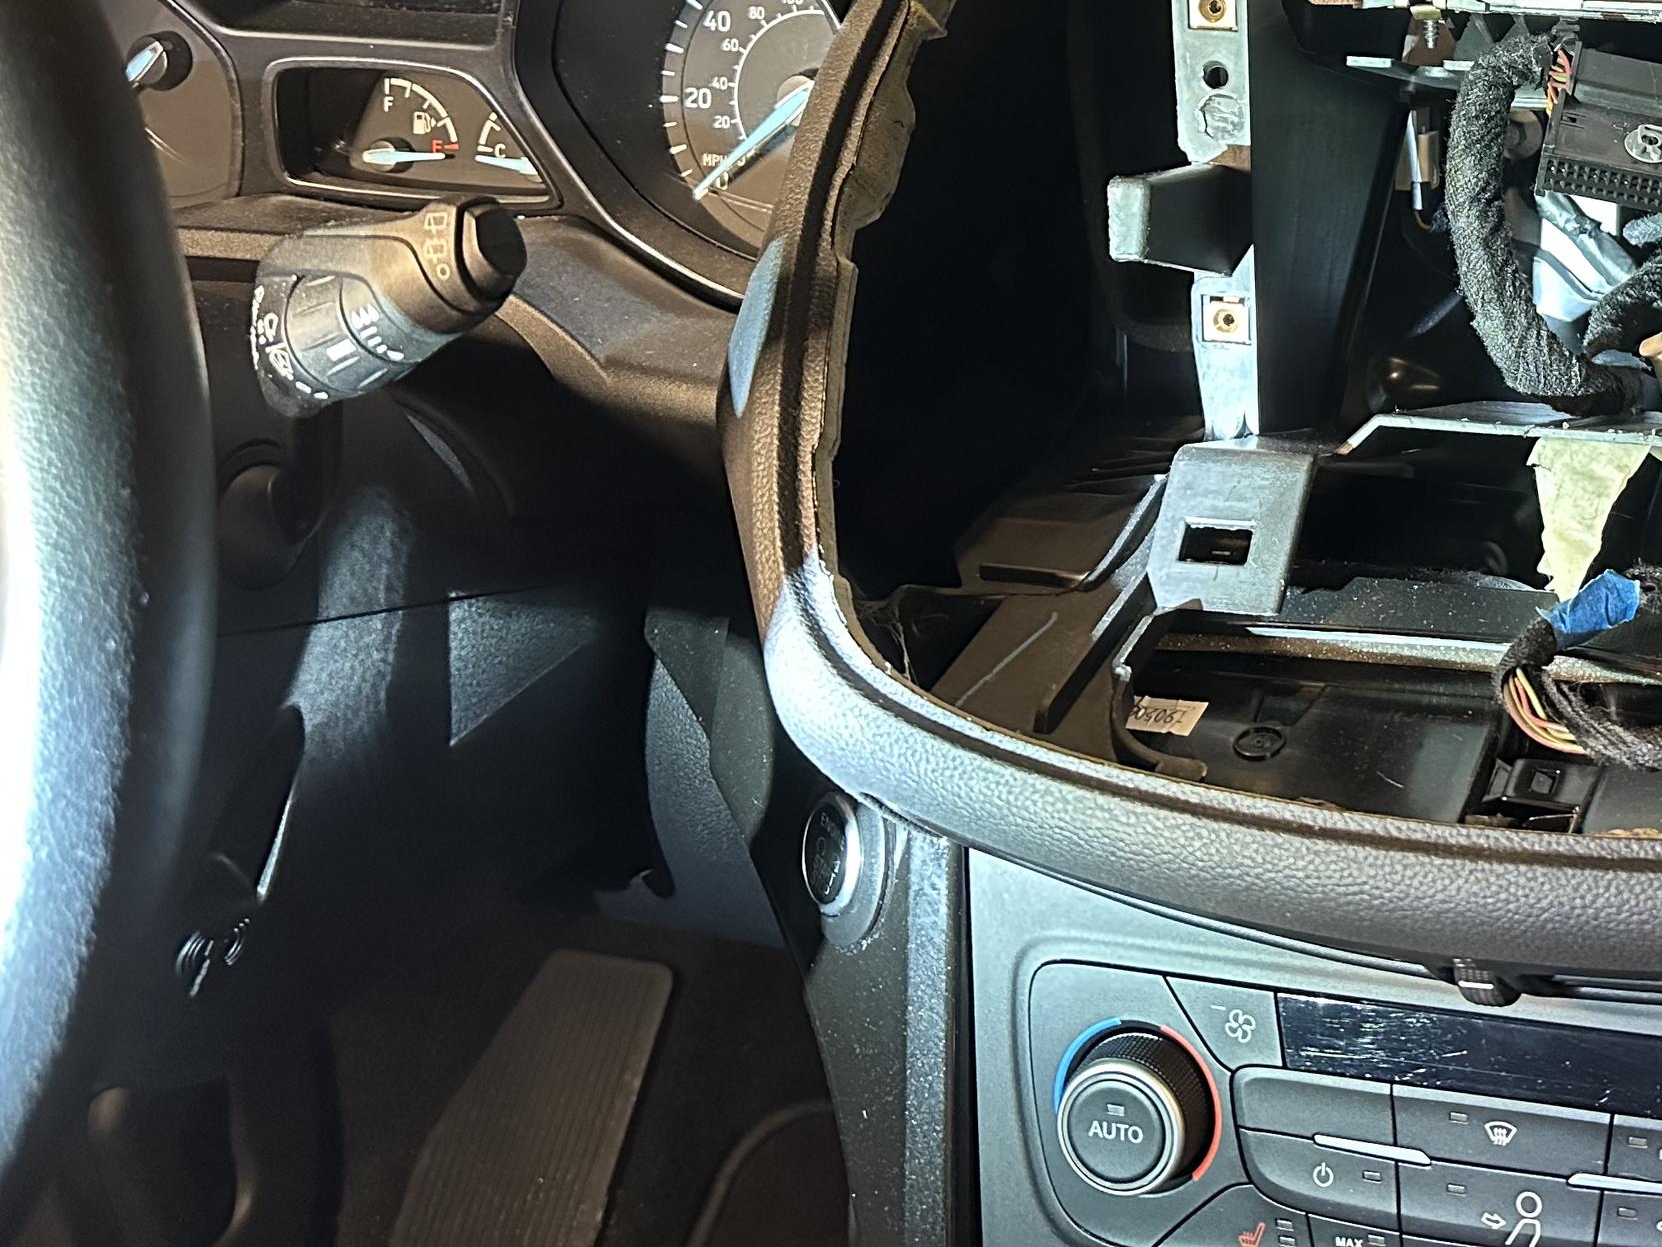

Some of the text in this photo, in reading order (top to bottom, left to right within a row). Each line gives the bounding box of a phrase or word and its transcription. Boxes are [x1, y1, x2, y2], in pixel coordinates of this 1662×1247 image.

[748, 7, 765, 20] 80
[703, 11, 731, 32] 40
[721, 39, 739, 52] 60
[711, 77, 728, 90] 40
[384, 97, 394, 112] F
[684, 87, 712, 108] 20
[713, 115, 730, 129] 20
[494, 143, 506, 159] C
[1088, 1120, 1144, 1144] AUTO
[1335, 1236, 1364, 1247] MAX
